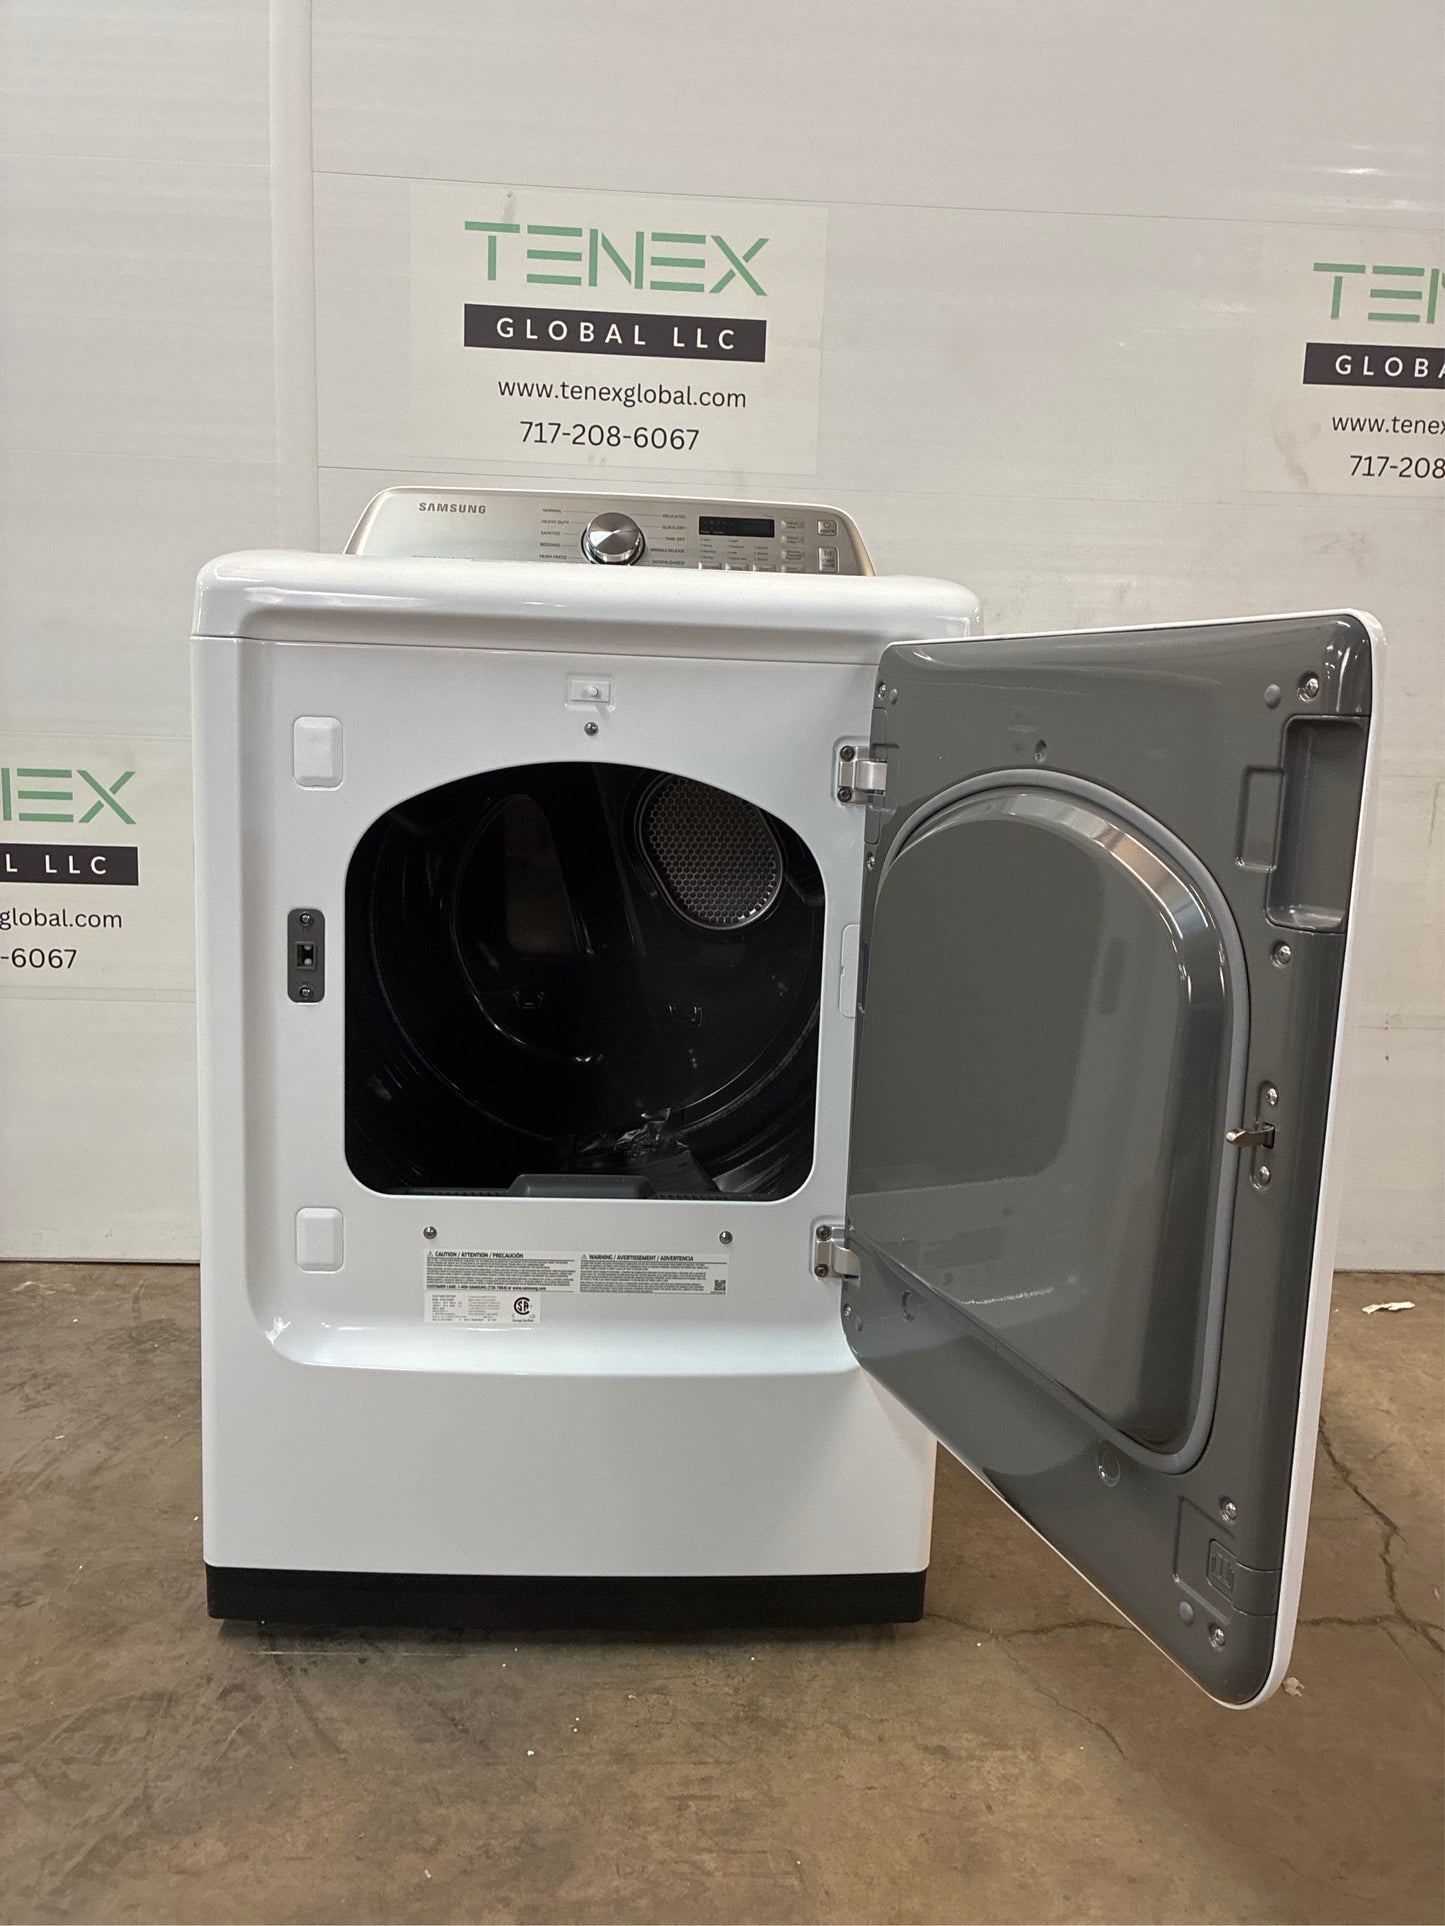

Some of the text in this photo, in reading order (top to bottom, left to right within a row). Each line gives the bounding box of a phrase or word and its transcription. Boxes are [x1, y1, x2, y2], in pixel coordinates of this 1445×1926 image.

[464, 220, 769, 296] TENEX
[496, 317, 735, 350] GLOBAL LLC
[498, 380, 747, 408] www.tenexglobal.com
[520, 420, 700, 451] 717-208-6067
[418, 502, 487, 515] SAMSUNG
[1, 767, 136, 824] EX
[45, 854, 107, 875] LLC
